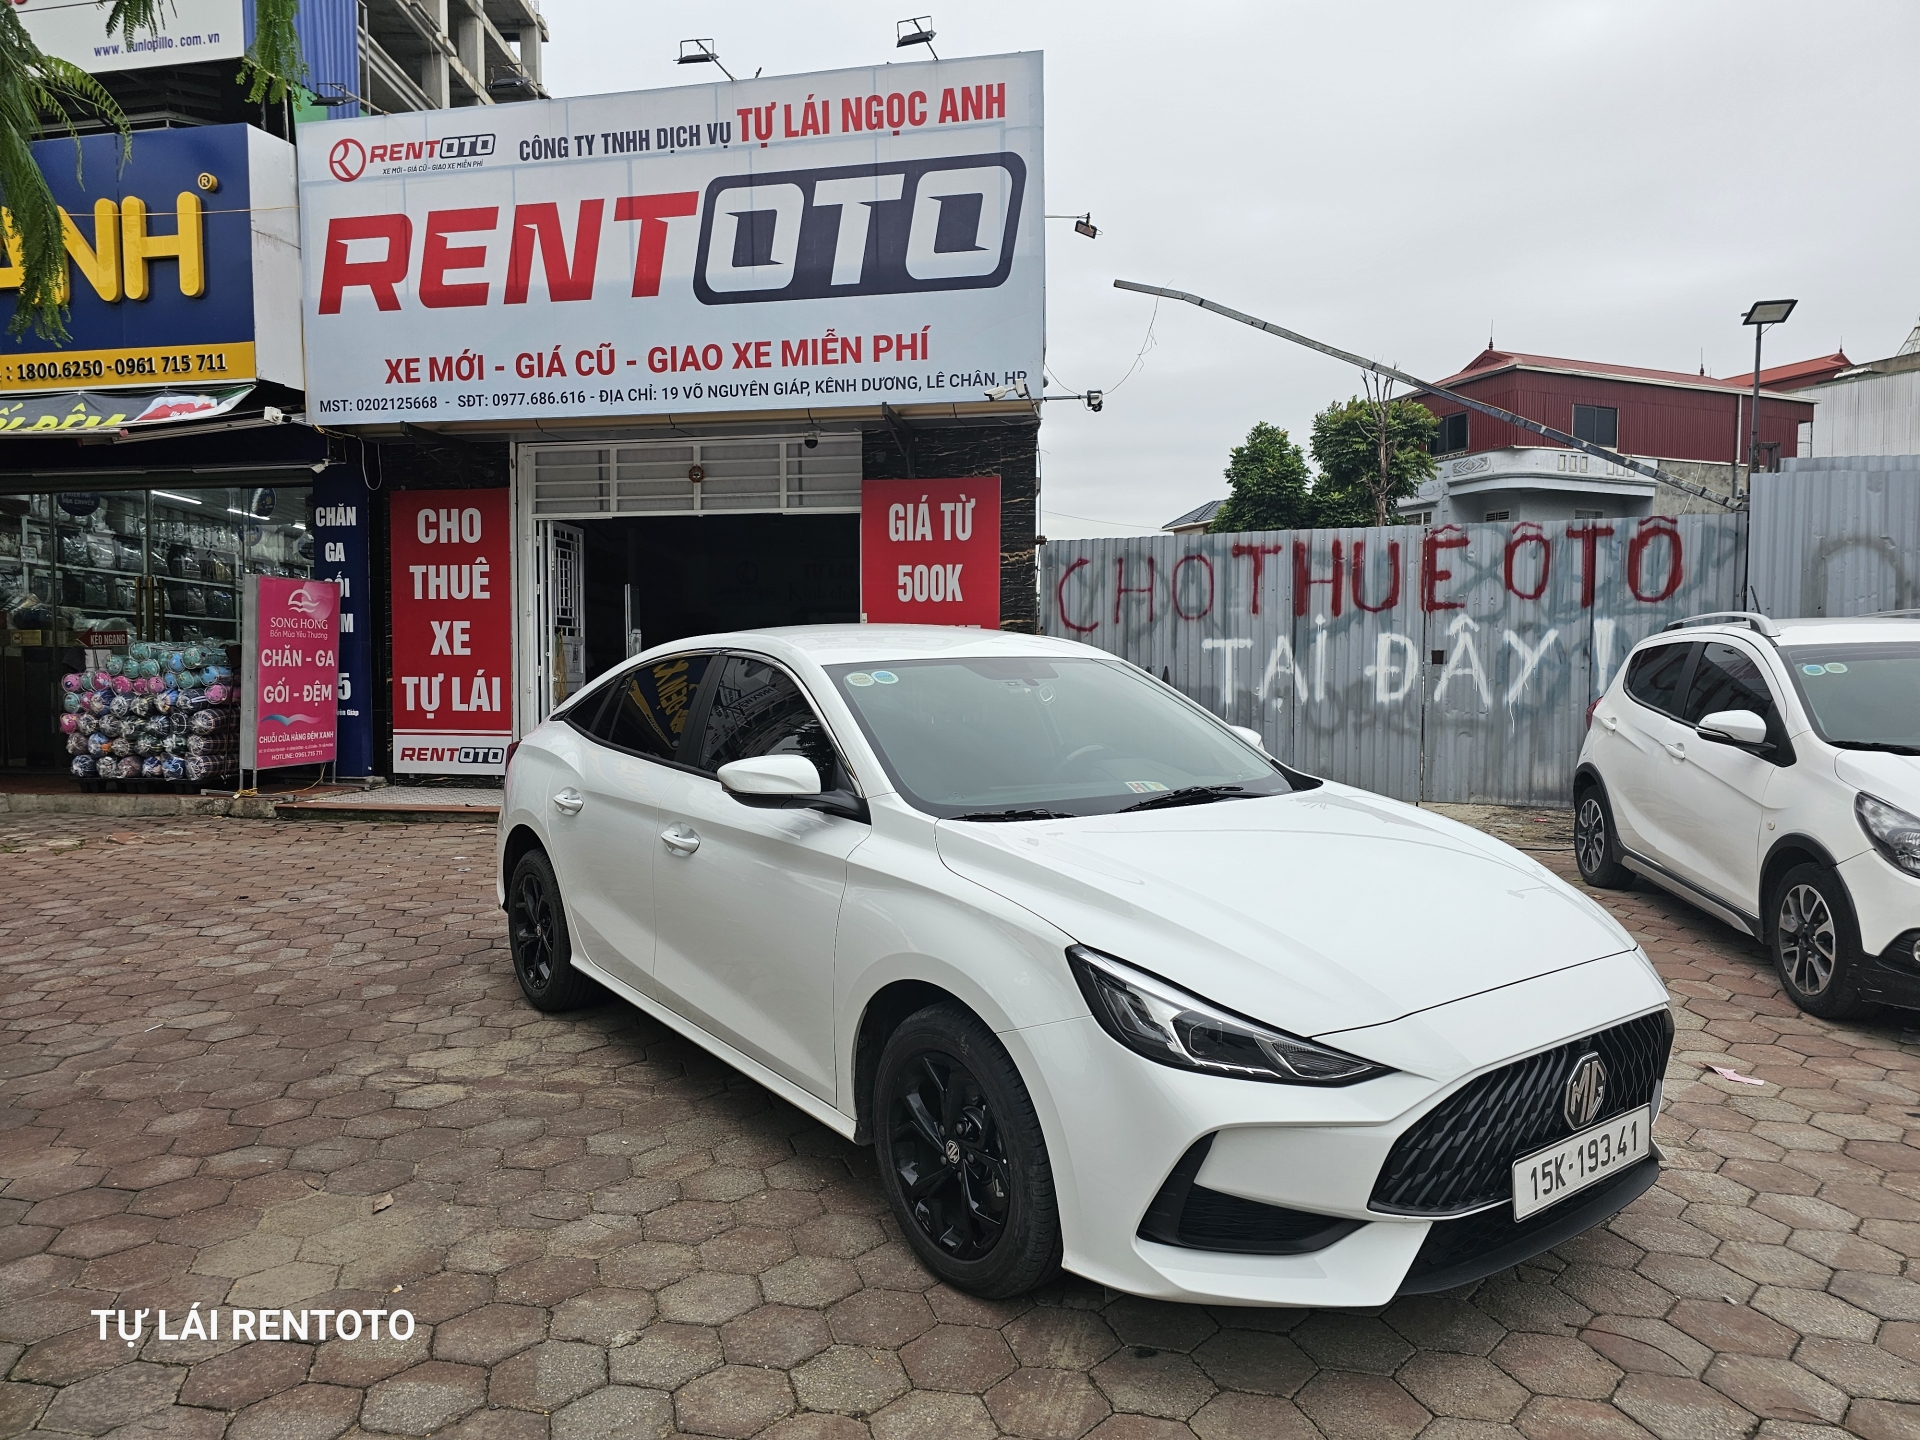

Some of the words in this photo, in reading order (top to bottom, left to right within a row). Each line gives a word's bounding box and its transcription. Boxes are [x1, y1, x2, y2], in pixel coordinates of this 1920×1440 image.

[519, 135, 568, 161] CÔNG
[574, 134, 595, 156] TY
[601, 129, 650, 154] TNHH
[656, 124, 700, 154] DỊCH
[707, 121, 731, 148] VỤ
[737, 102, 777, 148] TỰ
[784, 94, 830, 138] LÁI
[841, 90, 927, 136] NGỌC
[938, 83, 1006, 123] ANH
[407, 165, 417, 173] GIÁ
[418, 164, 427, 172] CŨ
[448, 162, 456, 170] XE
[472, 159, 484, 168] PHÍ
[161, 354, 191, 373] 715
[196, 353, 227, 371] 711
[385, 357, 421, 385] XE
[428, 348, 485, 382] MỚI
[515, 345, 567, 379] GIÁ
[575, 342, 615, 377] CŨ
[648, 343, 723, 373] GIAO
[731, 340, 772, 370] XE
[781, 328, 862, 367] MIỄN
[873, 324, 931, 362] PHÍ
[319, 399, 353, 413] MST:
[356, 395, 438, 412] 0202125668
[457, 394, 489, 408] SĐT:
[492, 390, 586, 406] 0977.686.616
[599, 389, 624, 405] ĐỊA
[627, 384, 657, 401] CHỈ:
[662, 386, 678, 400] 19
[682, 382, 703, 399] VÕ
[707, 380, 769, 398] NGUYÊN
[772, 375, 811, 397] GIÁP,
[815, 376, 857, 394] KÊNH
[861, 373, 922, 391] DƯƠNG,
[926, 369, 945, 389] LÊ
[950, 368, 1000, 388] CHÂN,
[315, 503, 357, 527] CHĂN
[416, 507, 482, 544] CHO
[888, 494, 932, 542] GIÁ
[941, 494, 976, 541] TỪ
[325, 542, 345, 562] GA
[324, 571, 350, 598] ỐI
[409, 556, 491, 600] THUÊ
[897, 564, 964, 603] 500K
[1059, 554, 1214, 632] CHO
[1231, 524, 1470, 618] THUÊ
[270, 616, 298, 628] SONG
[300, 618, 328, 630] HONG
[270, 628, 282, 638] Bốn
[104, 634, 126, 644] NGANG
[430, 620, 471, 656] XE
[261, 644, 302, 667] CHĂN
[315, 649, 335, 667] GA
[263, 677, 290, 703] GỐI
[303, 680, 332, 706] ĐỆM
[337, 673, 351, 700] 5
[401, 673, 445, 719] TỰ
[451, 669, 501, 712] LÁI
[258, 732, 278, 744] CHUỖI
[278, 732, 290, 742] CỬA
[290, 732, 306, 742] HÀNG
[306, 730, 318, 742] ĐỆM
[318, 730, 334, 739] XANH
[272, 752, 294, 760] HOTLINE:
[1530, 1120, 1637, 1201] 15K-193.41
